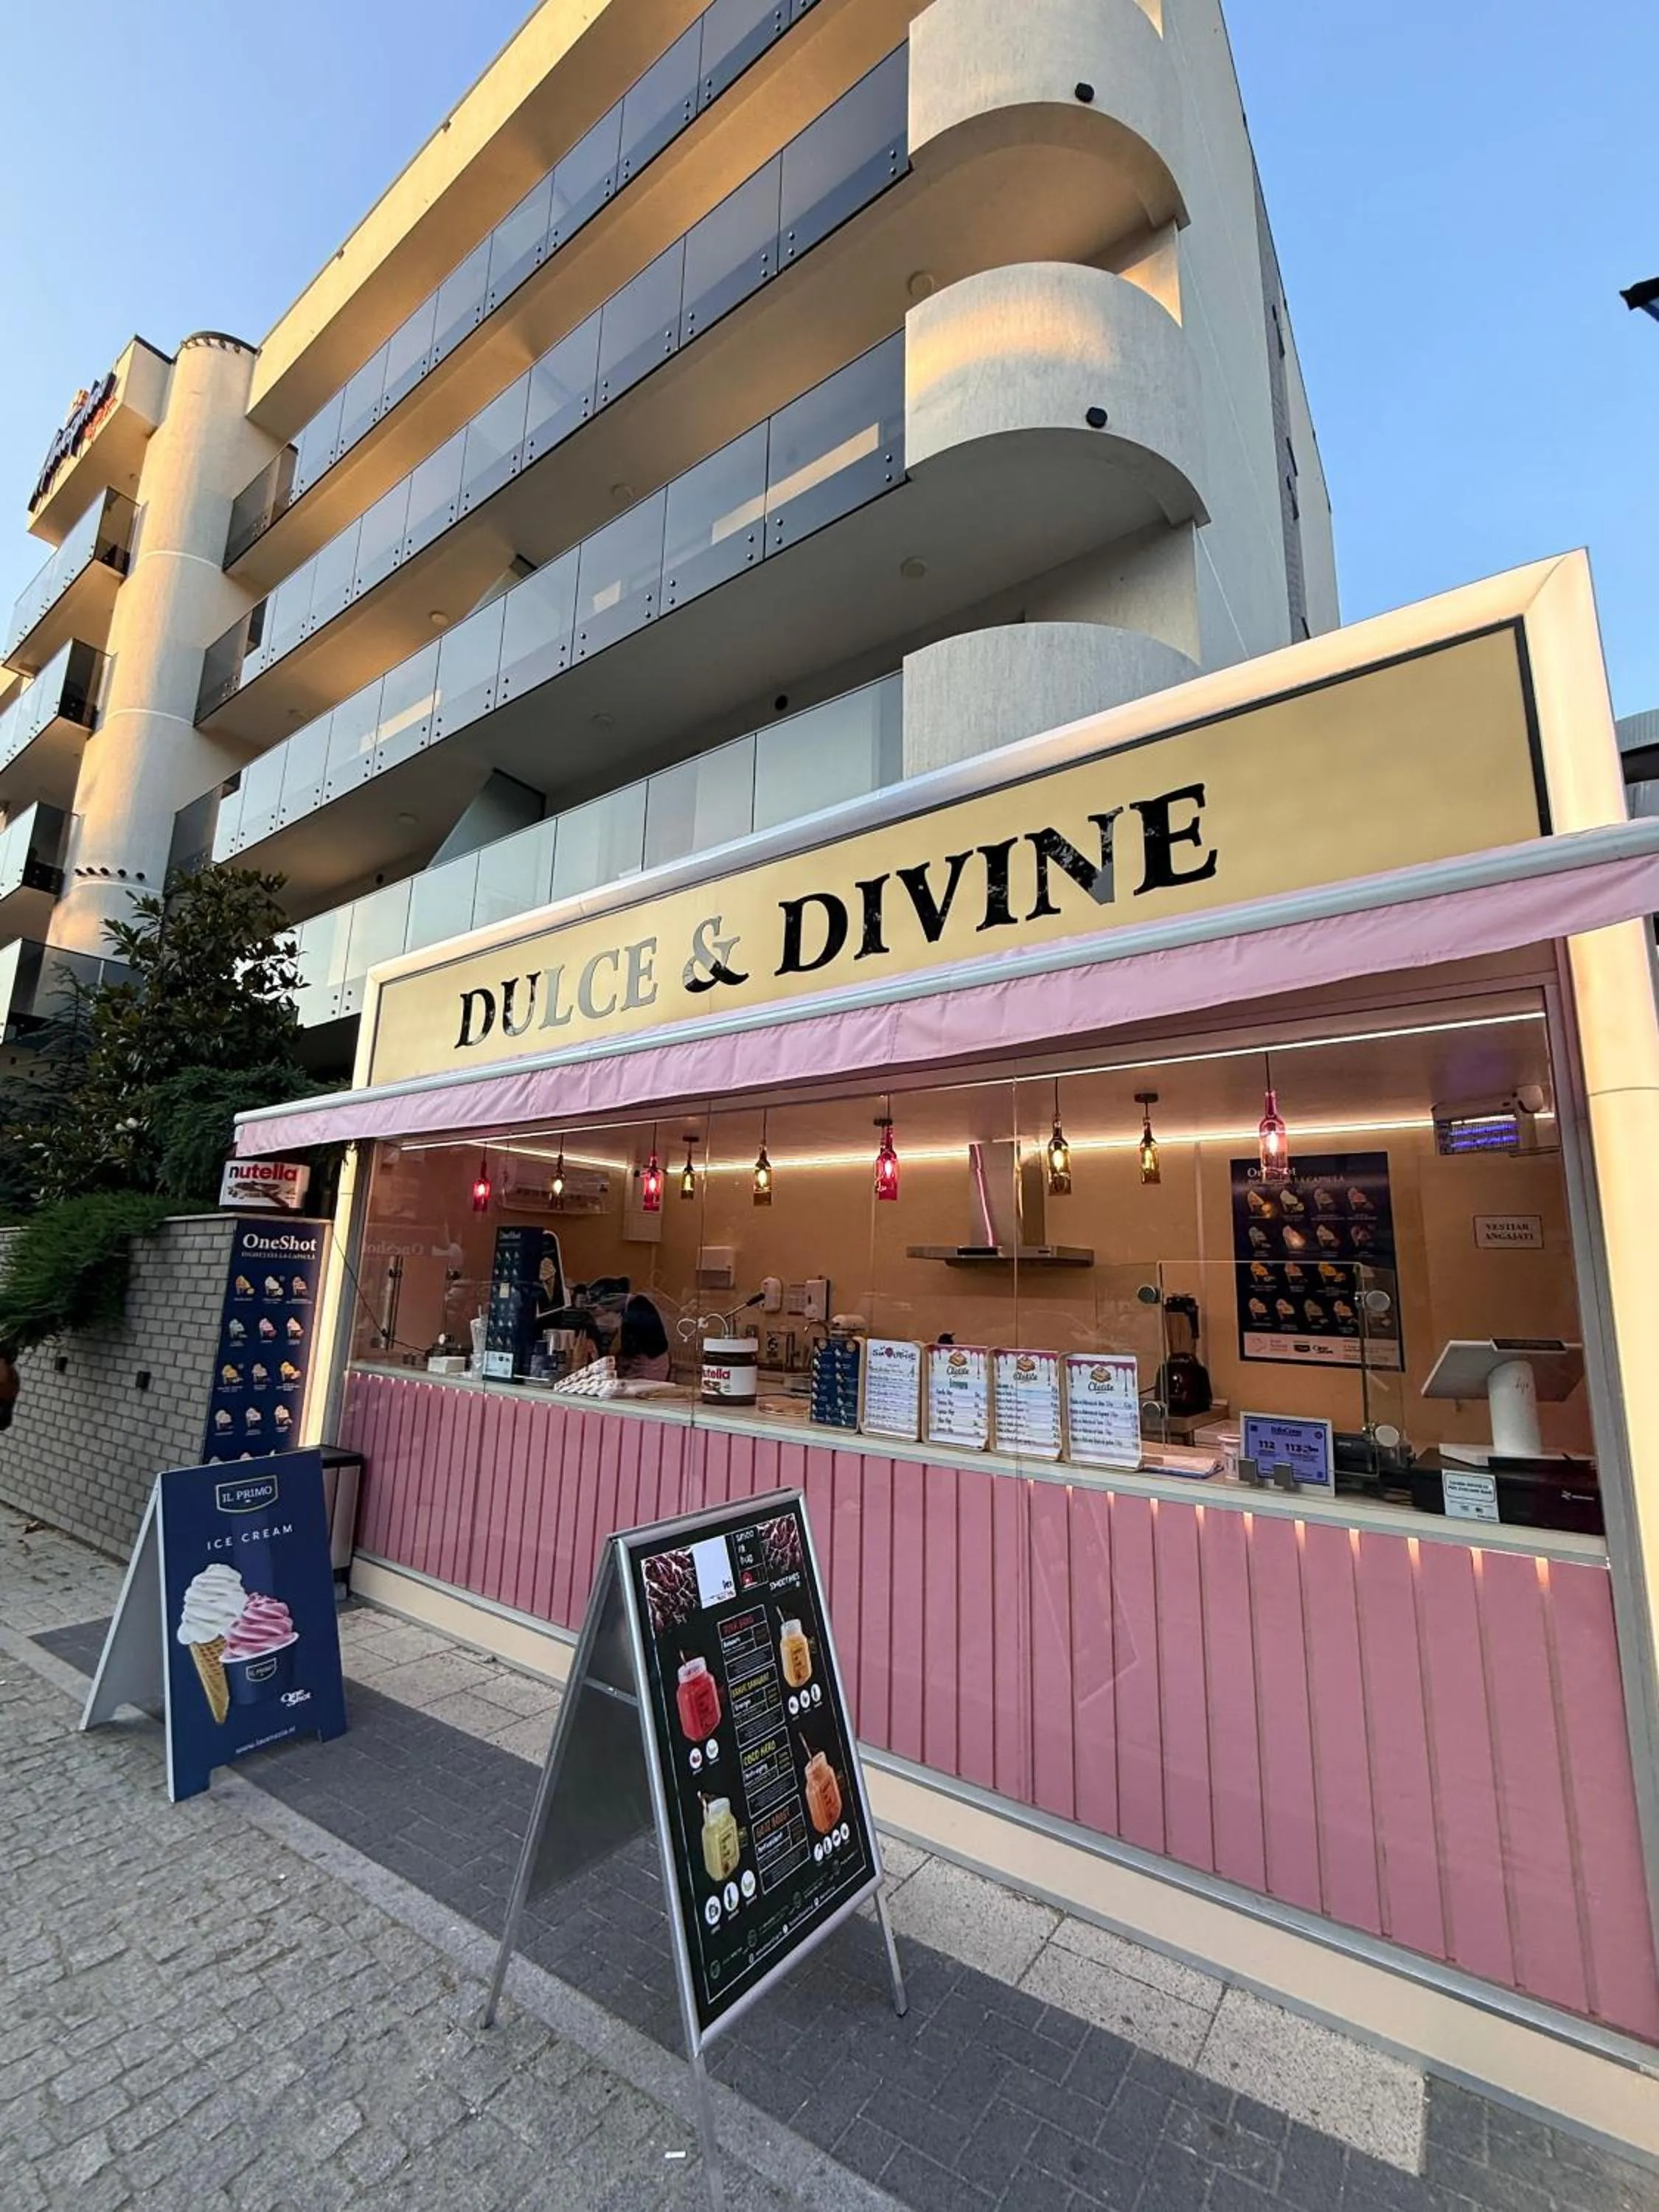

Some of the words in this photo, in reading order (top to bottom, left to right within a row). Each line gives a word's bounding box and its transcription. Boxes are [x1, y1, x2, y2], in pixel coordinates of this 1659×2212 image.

[453, 934, 658, 1051] DULCE
[682, 915, 750, 994] &
[774, 782, 1219, 976] DIVINE
[229, 1164, 298, 1181] nutella
[243, 1233, 317, 1251] OneShot
[222, 1492, 234, 1503] IL
[236, 1486, 272, 1500] PRIMO
[207, 1536, 234, 1551] ICE
[240, 1524, 293, 1543] CREAM
